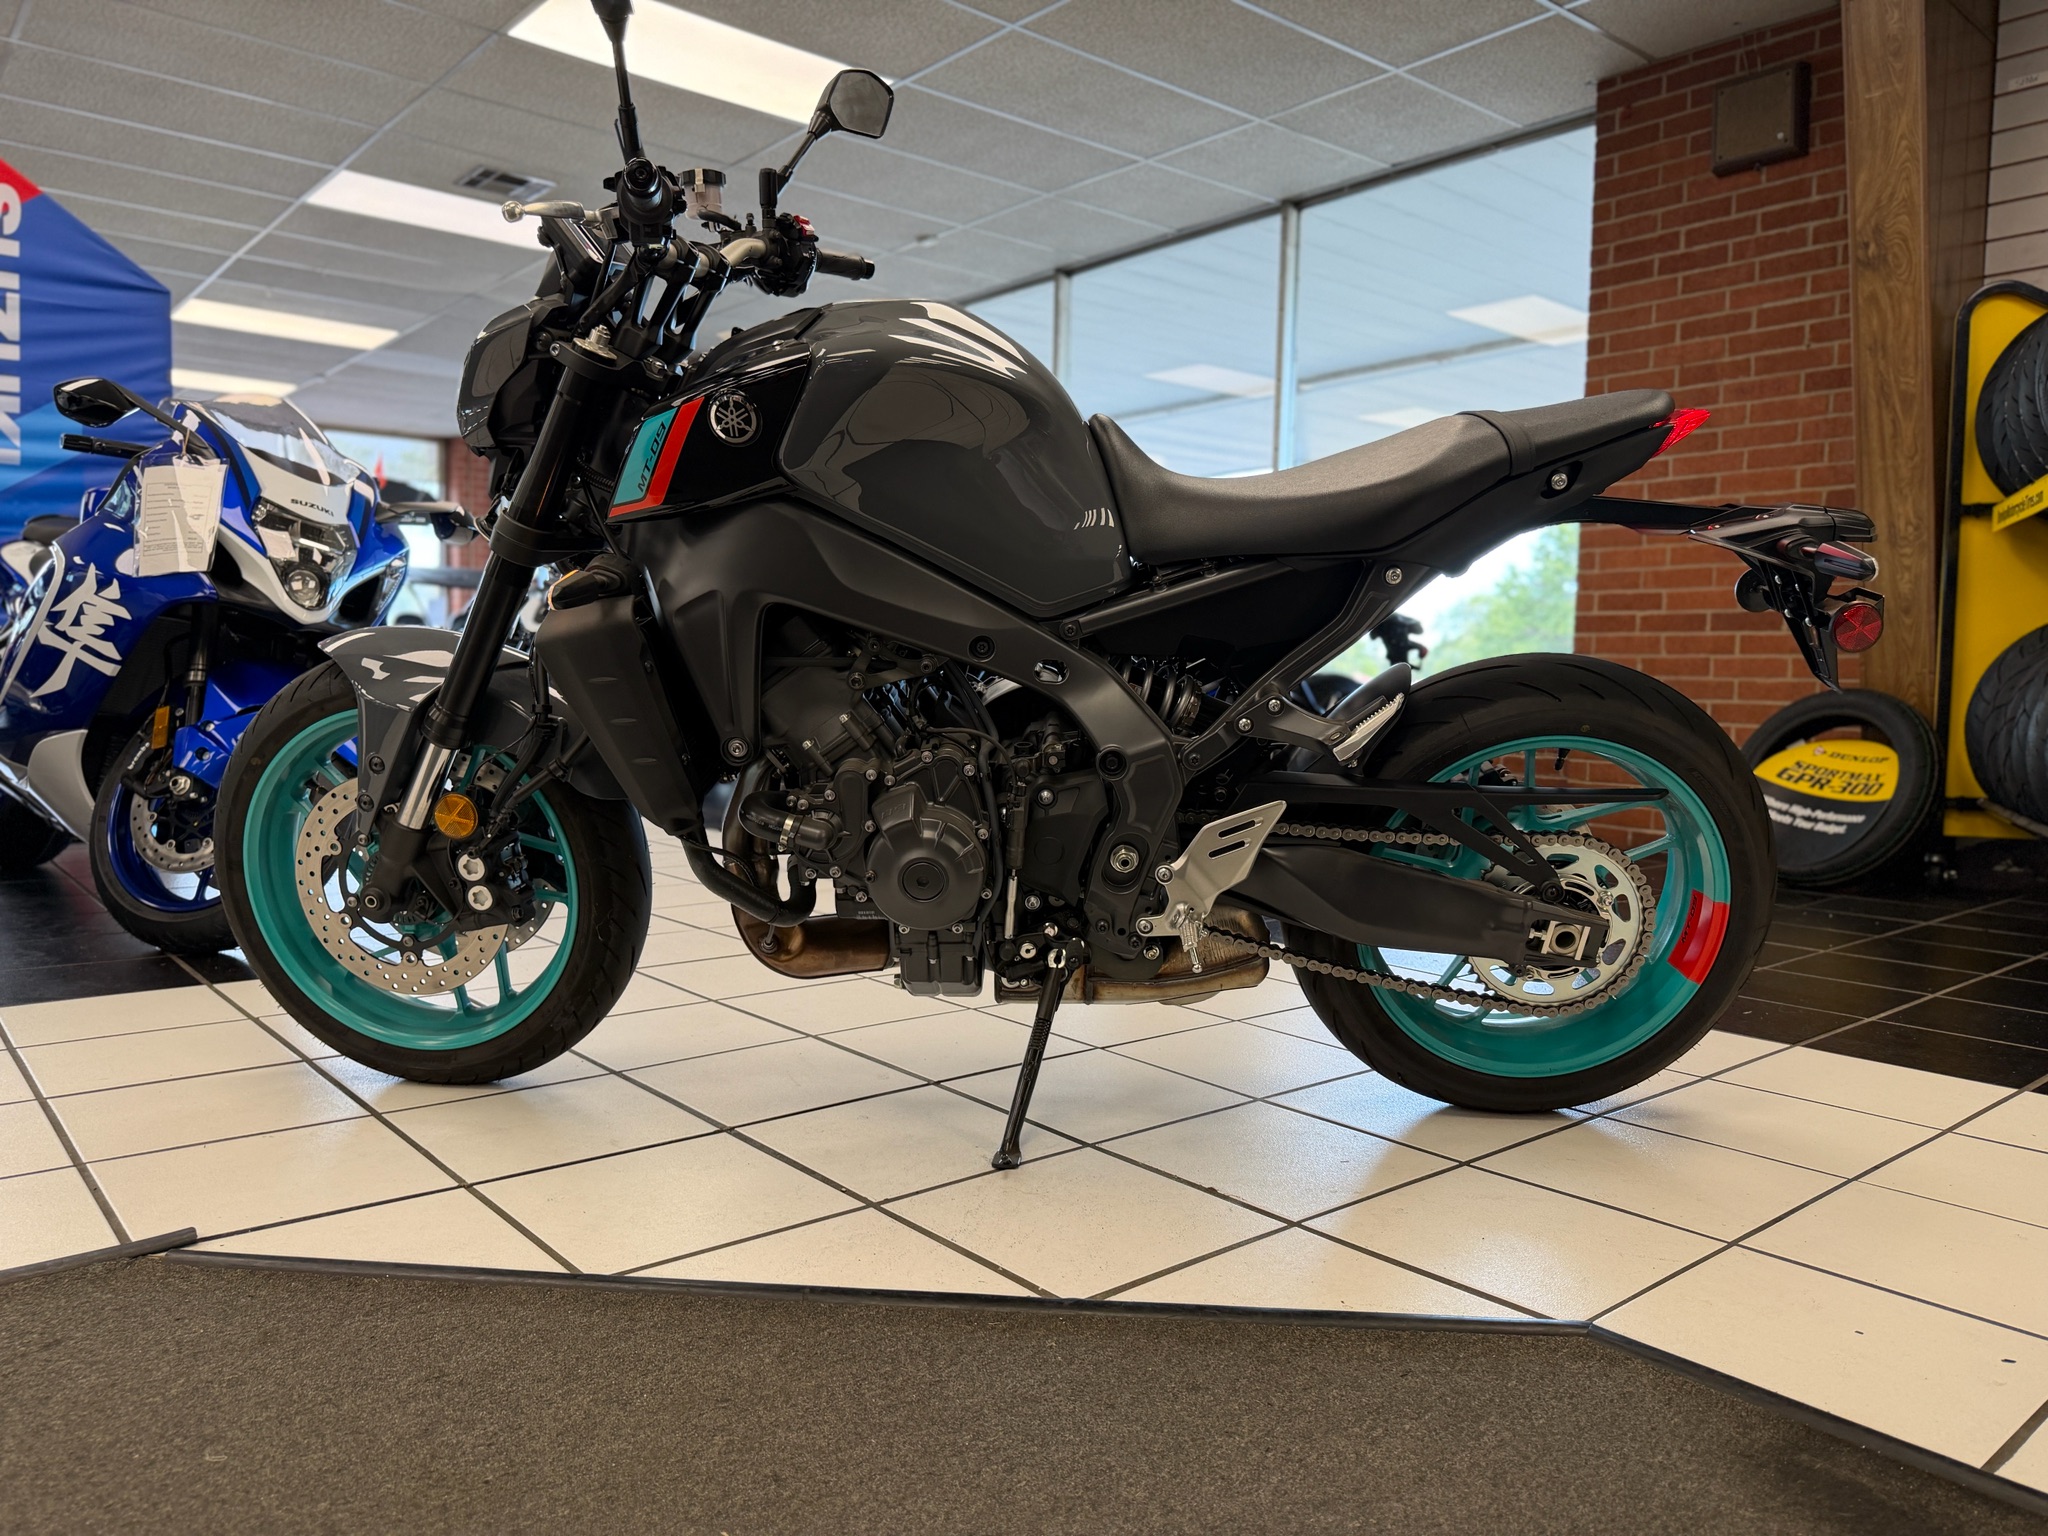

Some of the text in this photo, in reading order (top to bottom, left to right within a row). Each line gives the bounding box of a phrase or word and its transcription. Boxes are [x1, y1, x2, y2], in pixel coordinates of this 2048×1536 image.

[636, 421, 667, 493] MT-09
[290, 498, 335, 518] SUZUKI
[29, 562, 133, 698] 隼
[127, 741, 150, 770] brembo
[1828, 751, 1890, 764] DUNLOP
[1776, 767, 1885, 796] GPR-300
[1794, 759, 1885, 782] SPORTMAX
